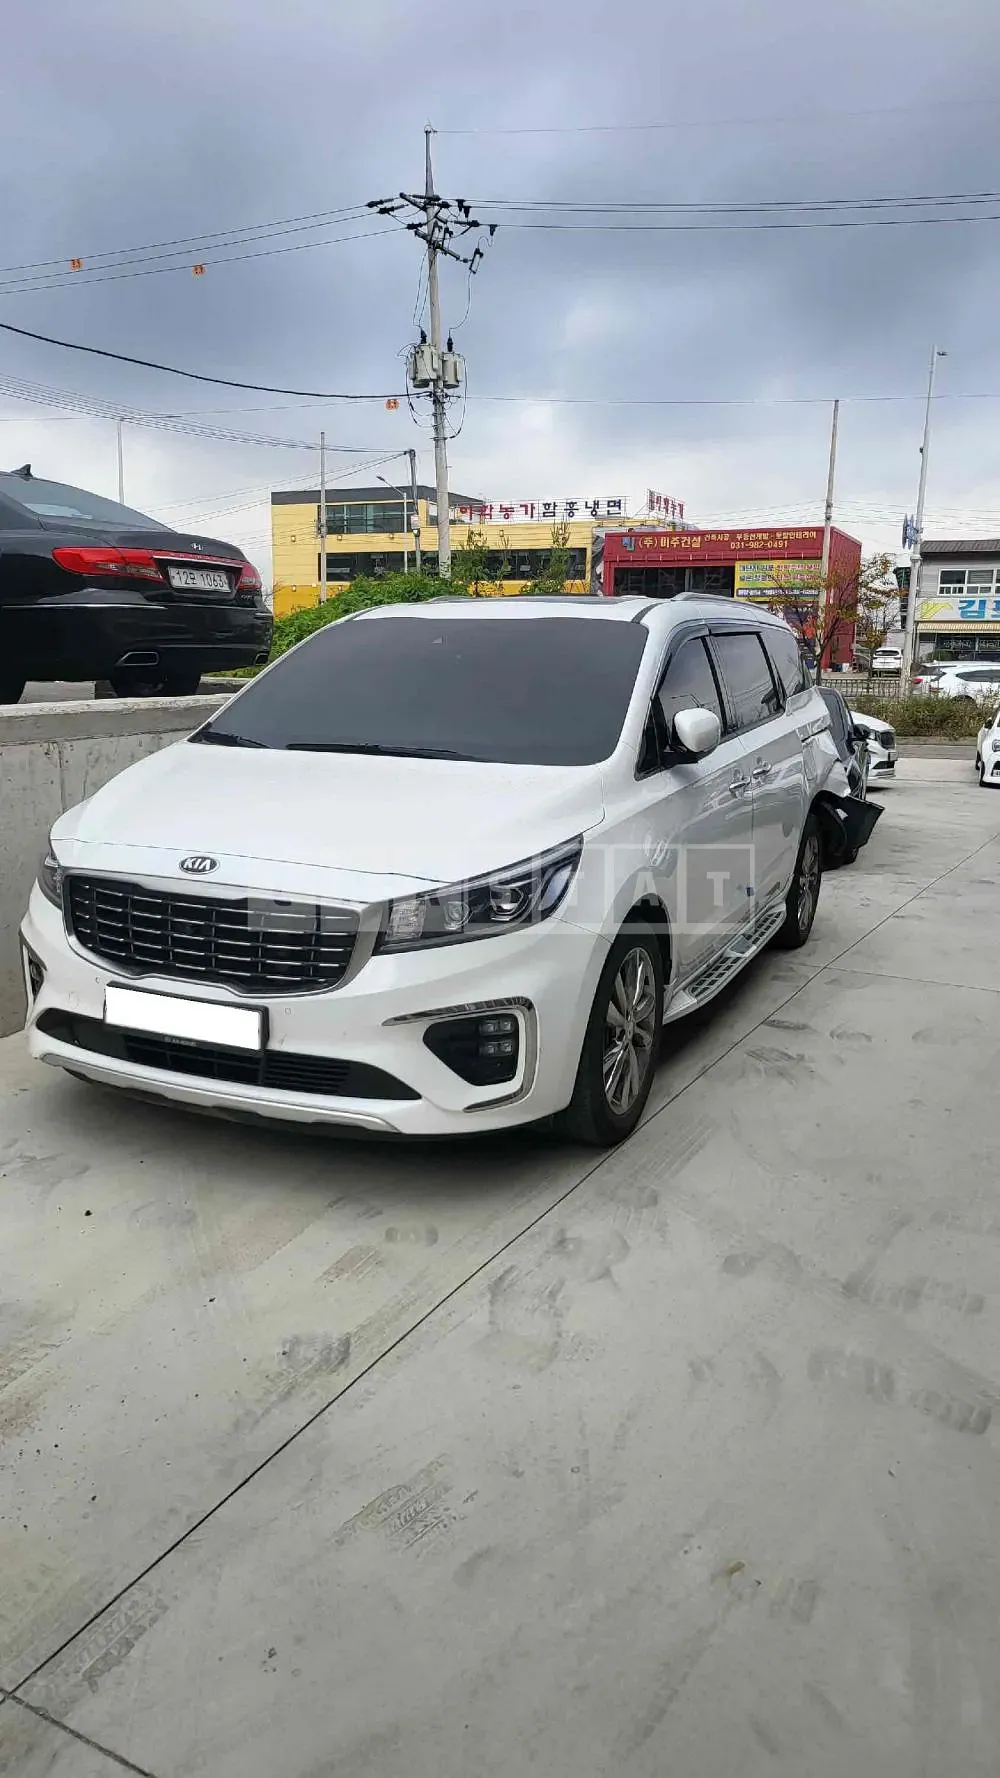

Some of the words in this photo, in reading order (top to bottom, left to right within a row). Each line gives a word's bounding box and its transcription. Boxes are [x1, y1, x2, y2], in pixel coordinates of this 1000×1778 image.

[542, 500, 621, 517] 함흥냉면
[639, 536, 658, 549] (주)
[183, 857, 212, 871] KIA
